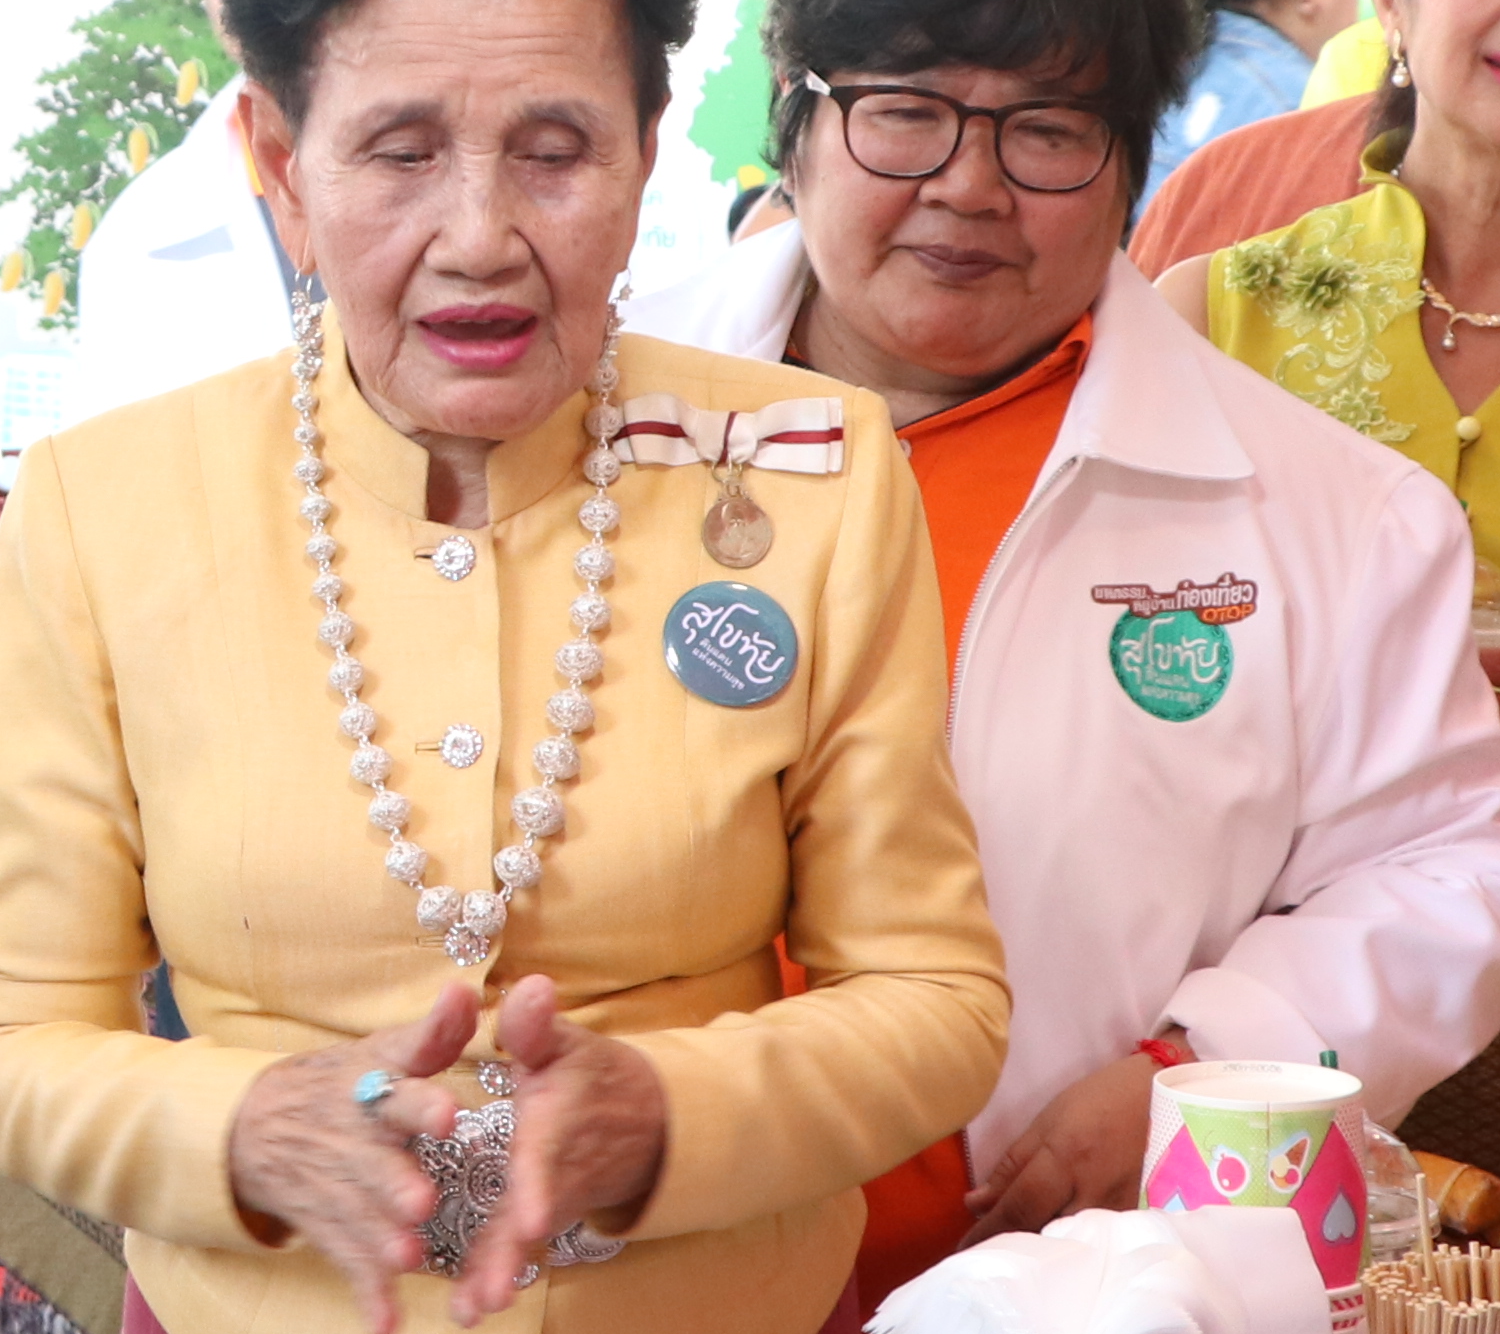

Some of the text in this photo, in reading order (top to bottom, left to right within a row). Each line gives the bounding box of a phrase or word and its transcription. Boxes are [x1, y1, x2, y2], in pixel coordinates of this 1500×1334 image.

[681, 601, 786, 685] สุโขทัย
[1202, 604, 1255, 622] OTOP
[1119, 616, 1222, 684] สุโขทัย
